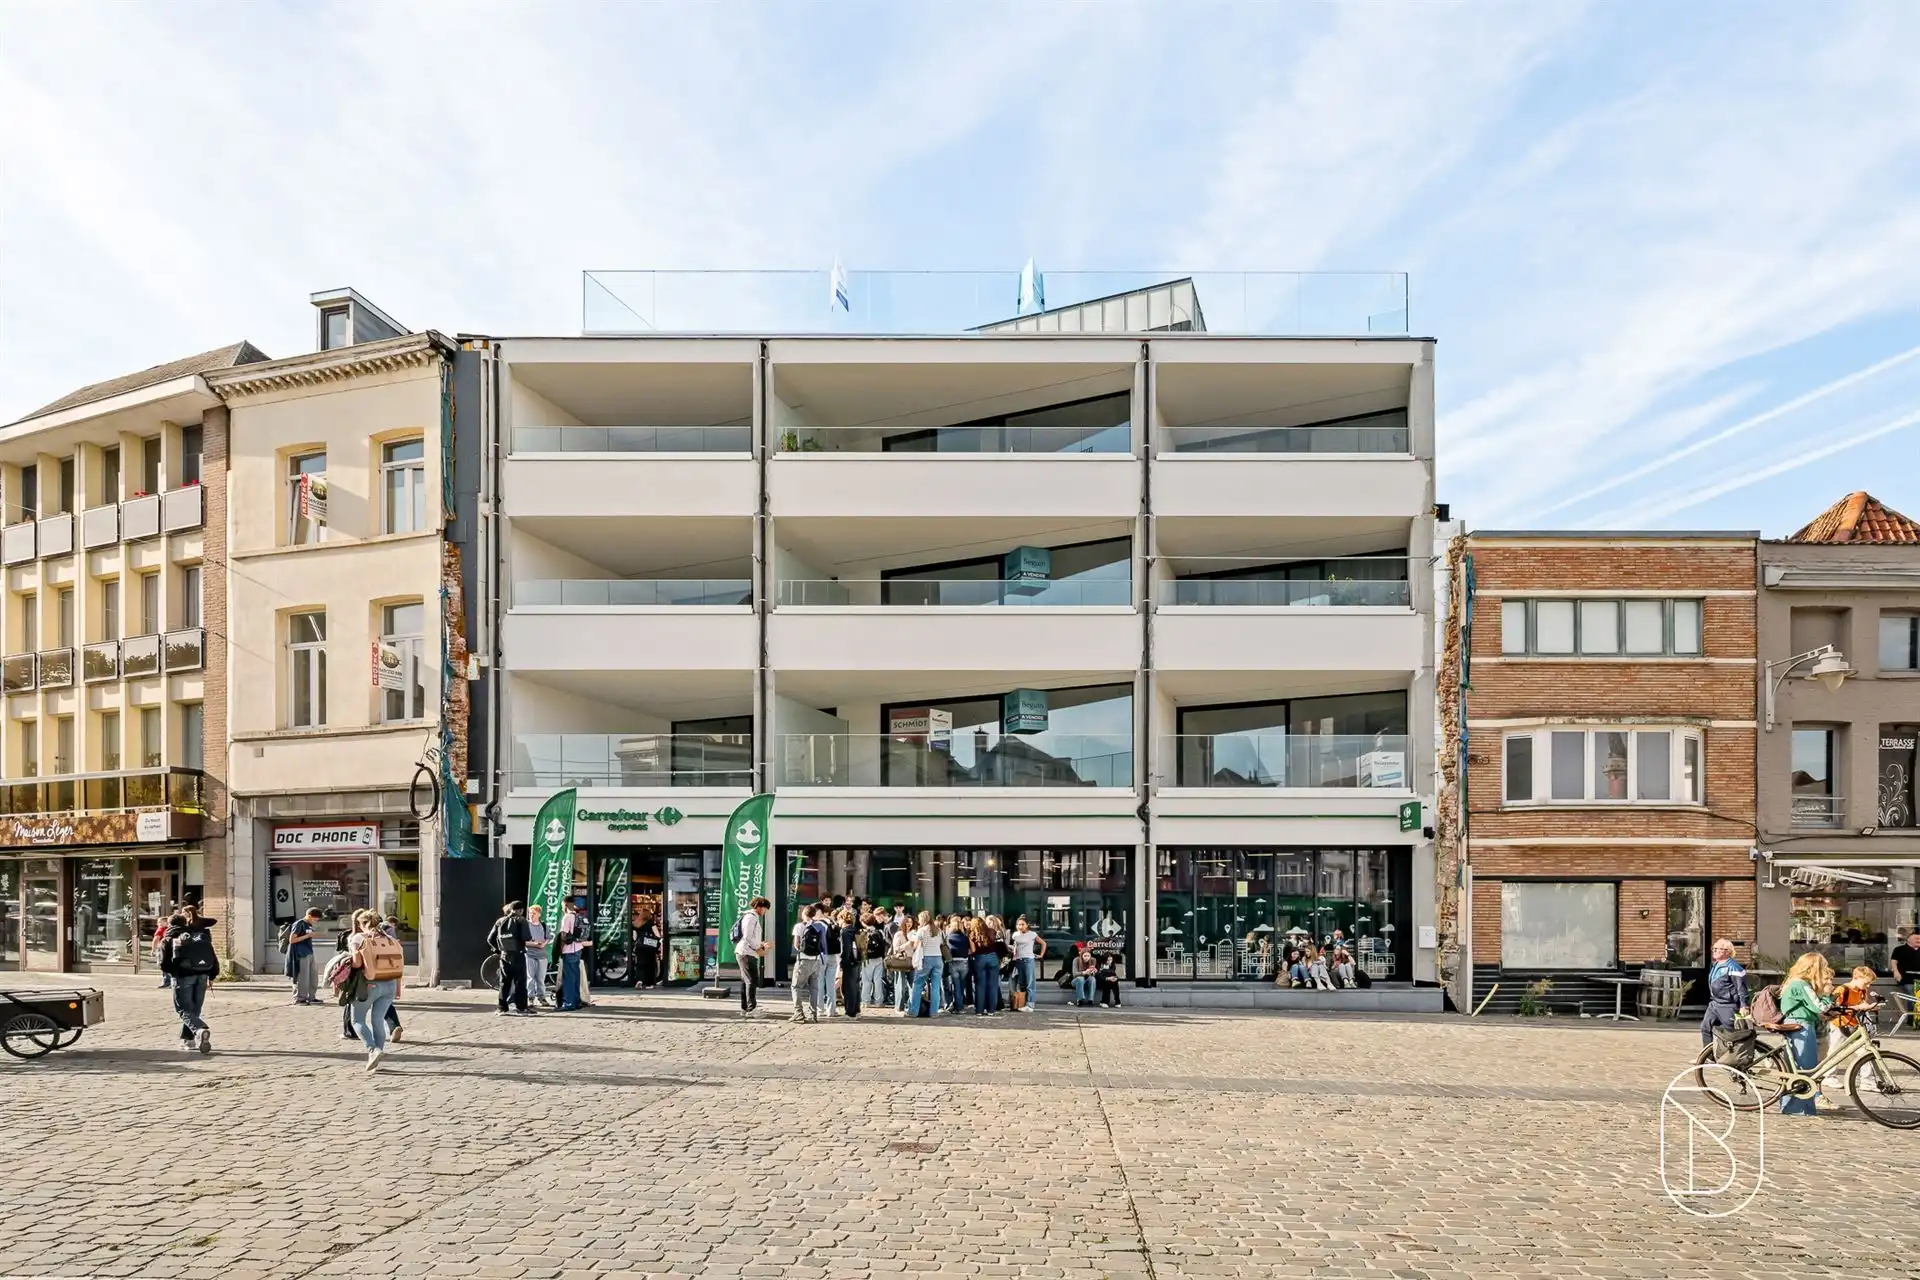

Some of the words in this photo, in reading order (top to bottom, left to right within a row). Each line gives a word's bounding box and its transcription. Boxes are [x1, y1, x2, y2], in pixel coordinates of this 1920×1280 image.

[1881, 738, 1915, 747] TERRASSE
[577, 808, 648, 821] Carrefour
[608, 824, 648, 833] express
[276, 833, 304, 844] DOC
[311, 831, 358, 843] PHONE
